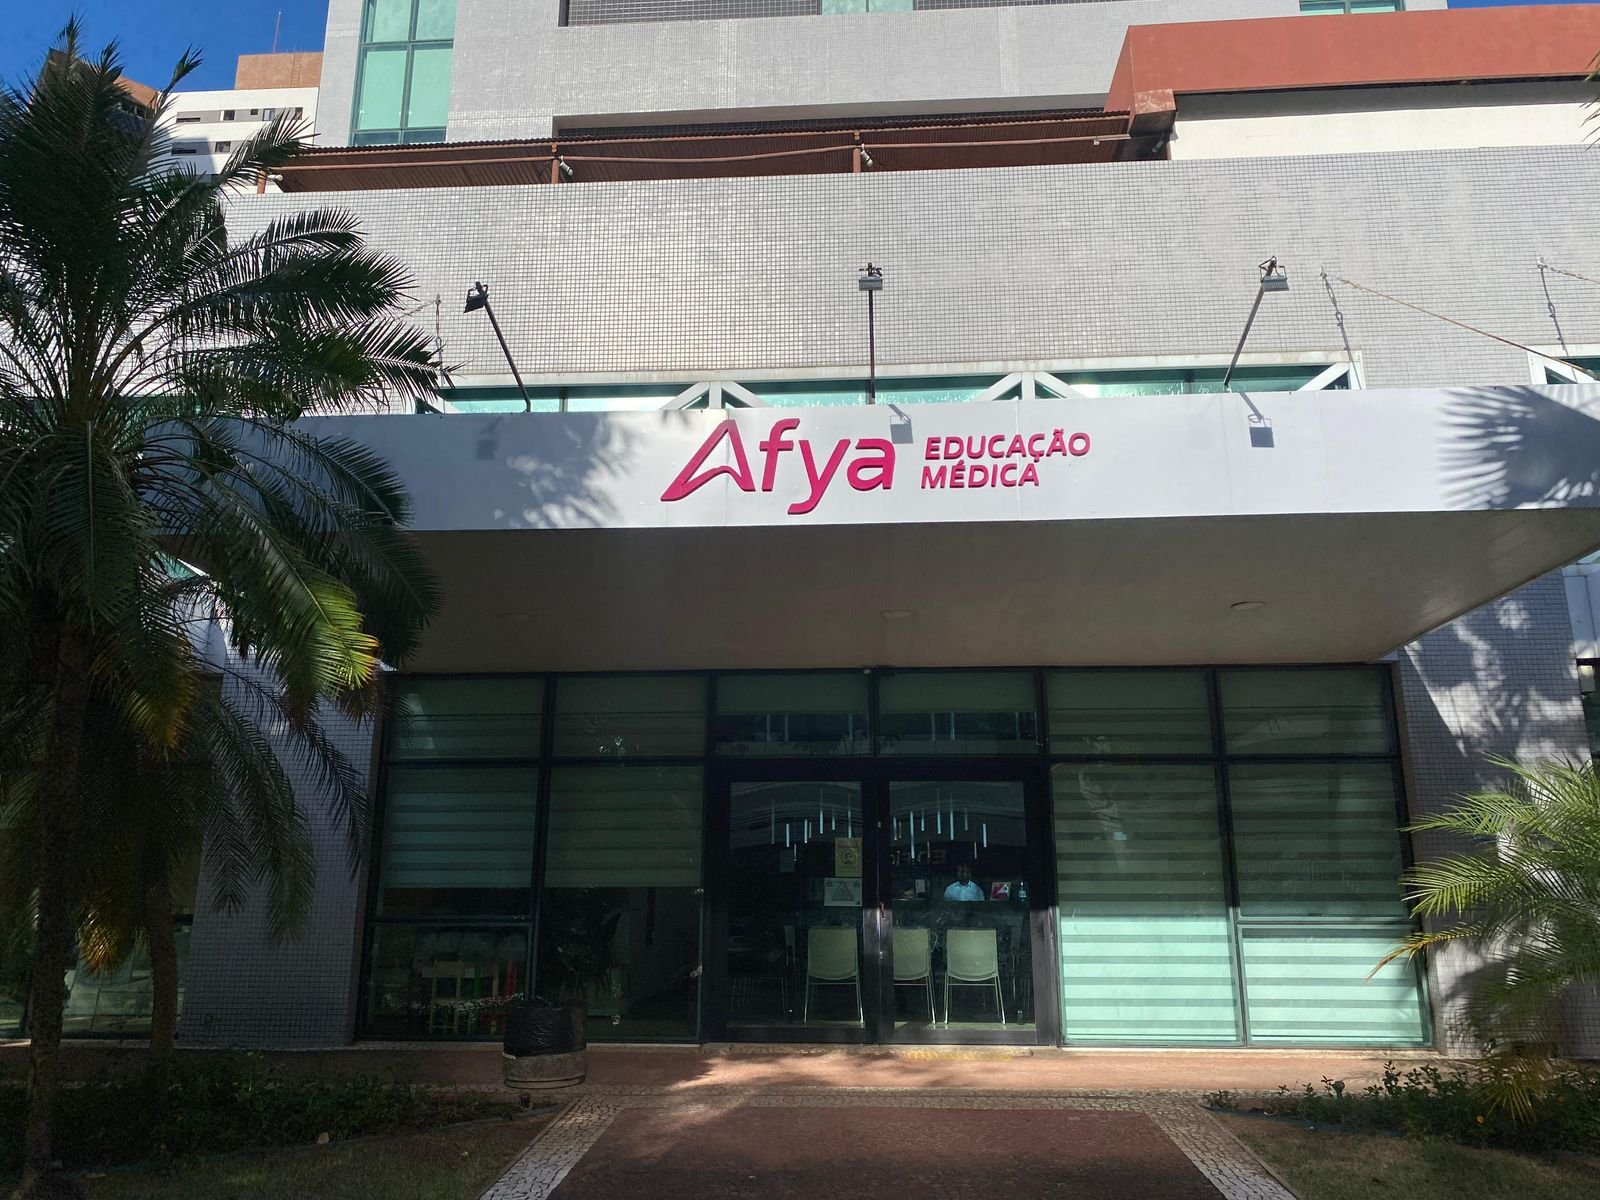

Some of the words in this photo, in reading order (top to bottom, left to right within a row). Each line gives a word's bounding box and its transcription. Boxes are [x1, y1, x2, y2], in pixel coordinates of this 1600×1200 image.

[925, 428, 1091, 463] EDUCAÇÃO
[660, 418, 896, 515] Afya
[921, 461, 1040, 490] MÉDICA
